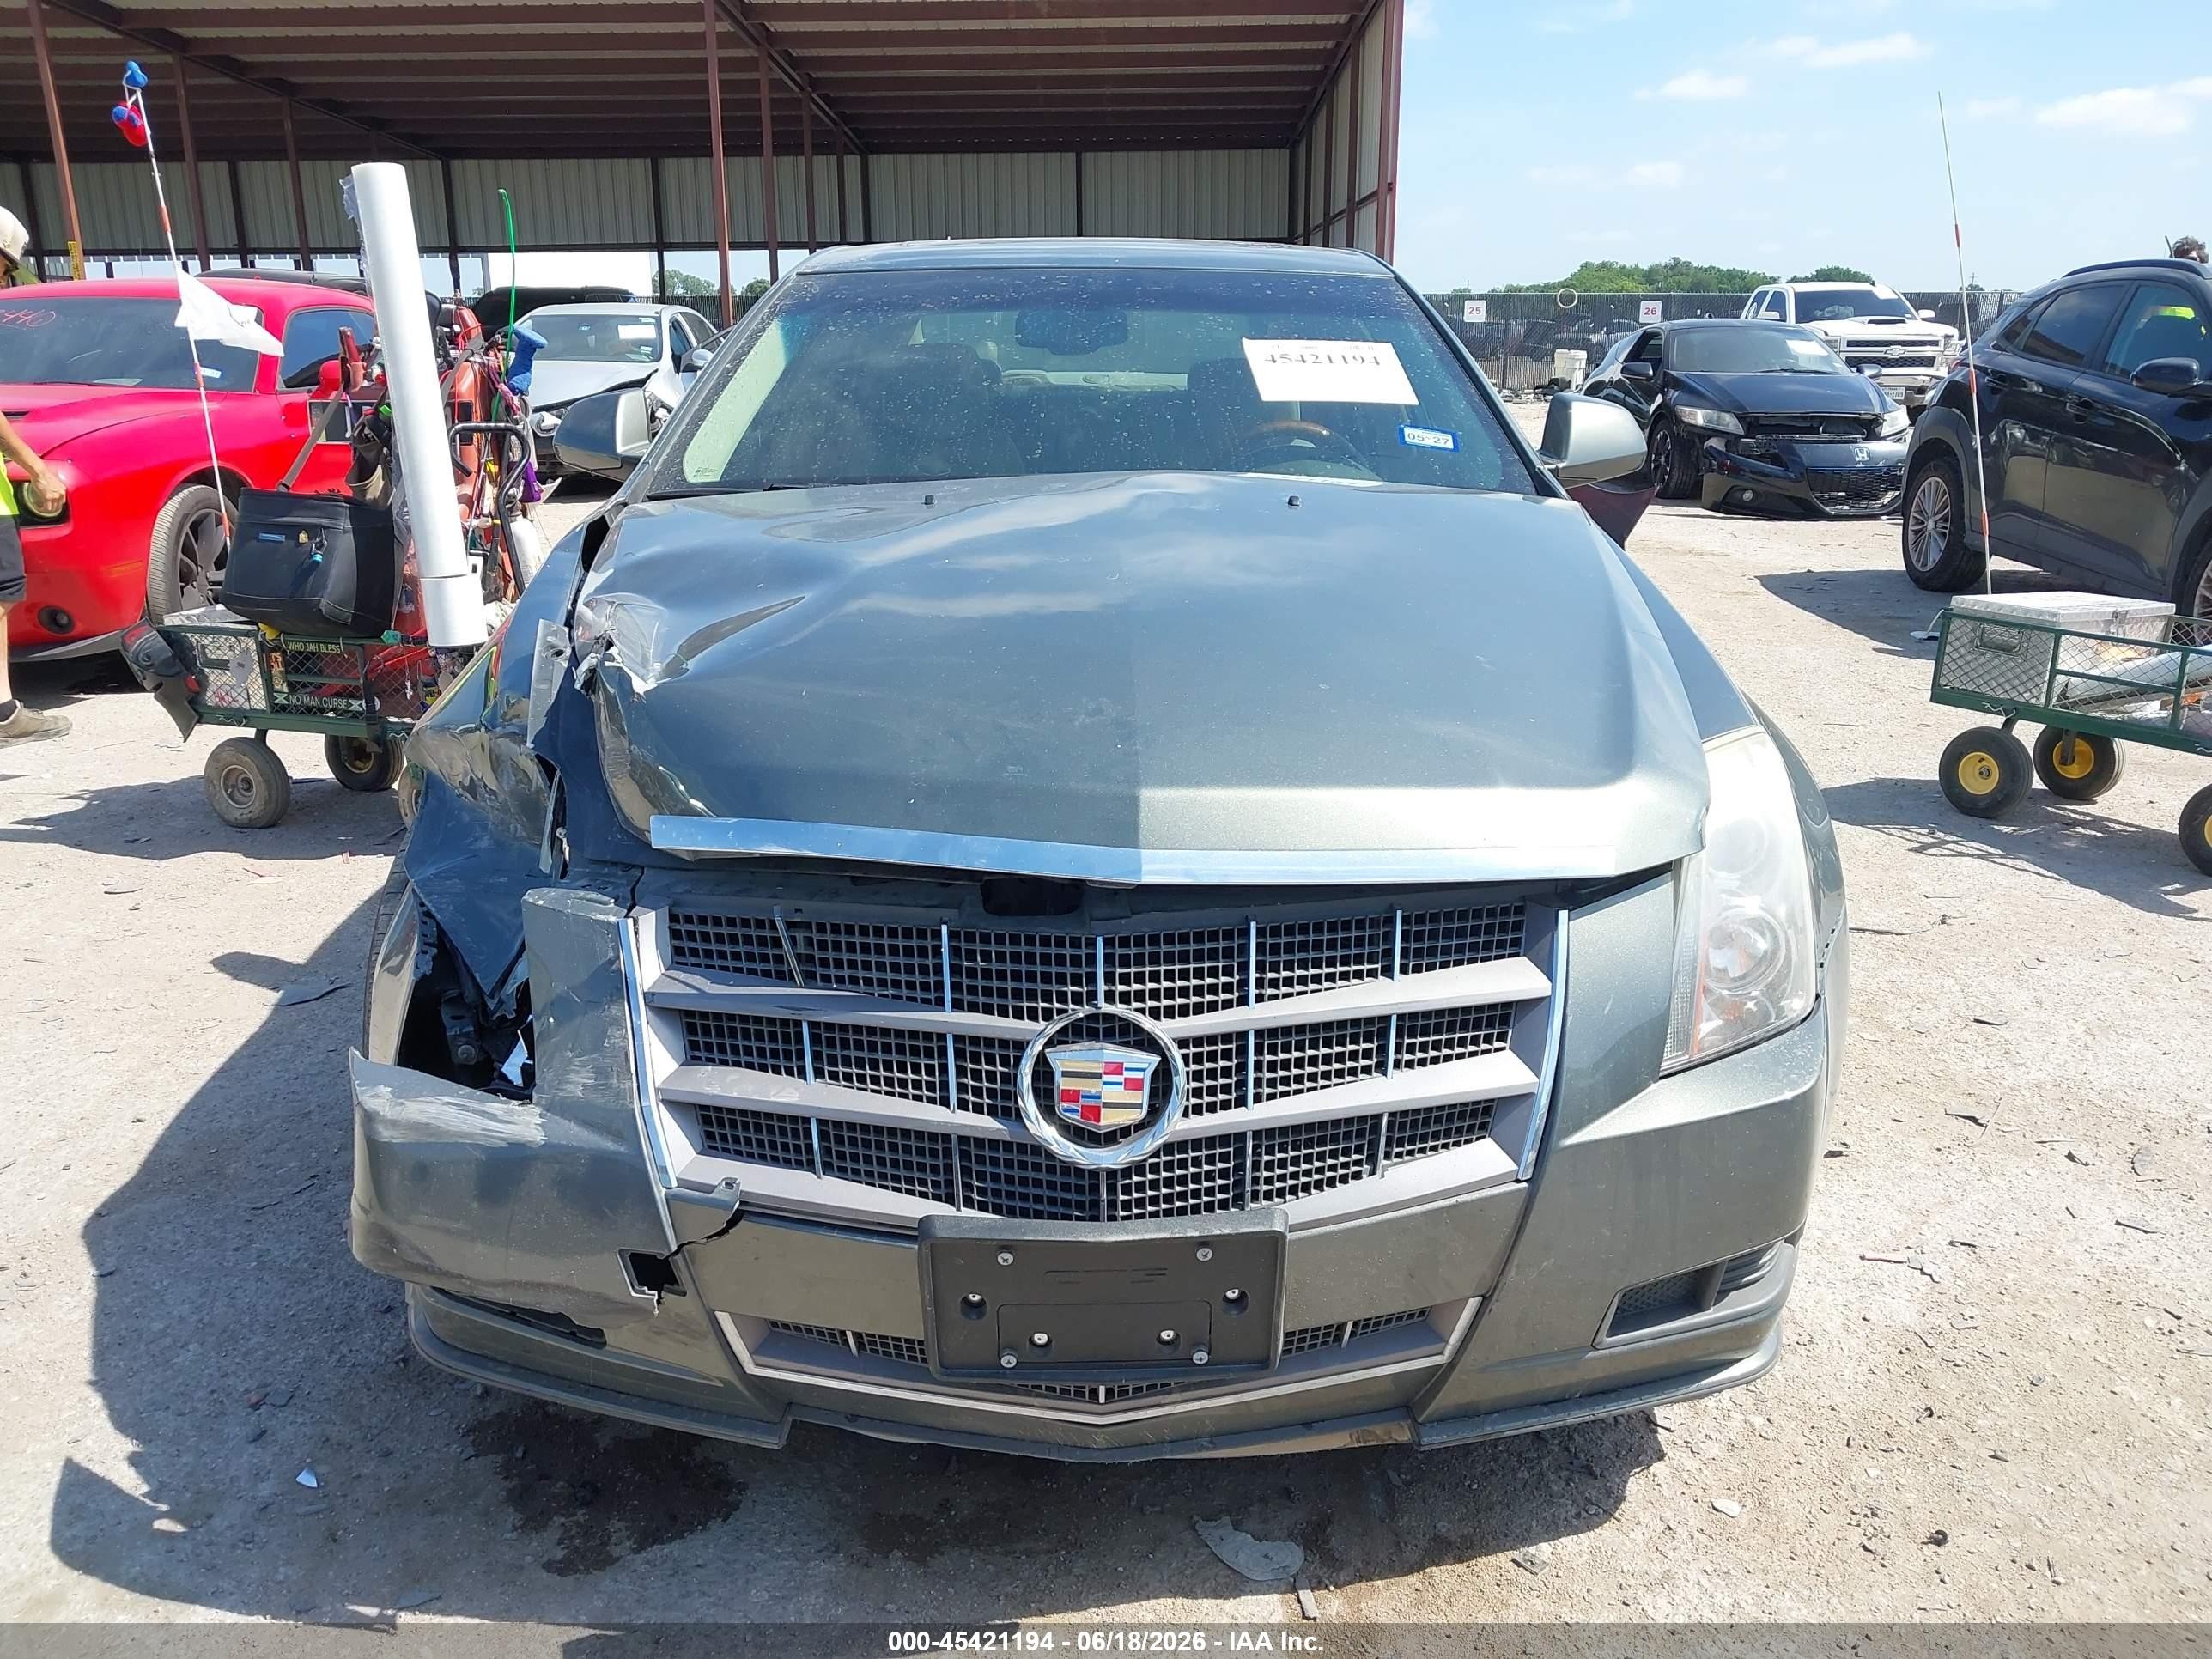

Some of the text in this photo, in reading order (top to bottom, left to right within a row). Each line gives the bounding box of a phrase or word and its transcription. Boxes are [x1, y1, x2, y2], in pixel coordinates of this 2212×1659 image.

[1468, 306, 1482, 315] 25
[1644, 307, 1658, 316] 26
[1264, 353, 1381, 366] 45421194
[288, 641, 341, 653] WHO JAH BLESS
[289, 694, 348, 709] NO MAN CURSE
